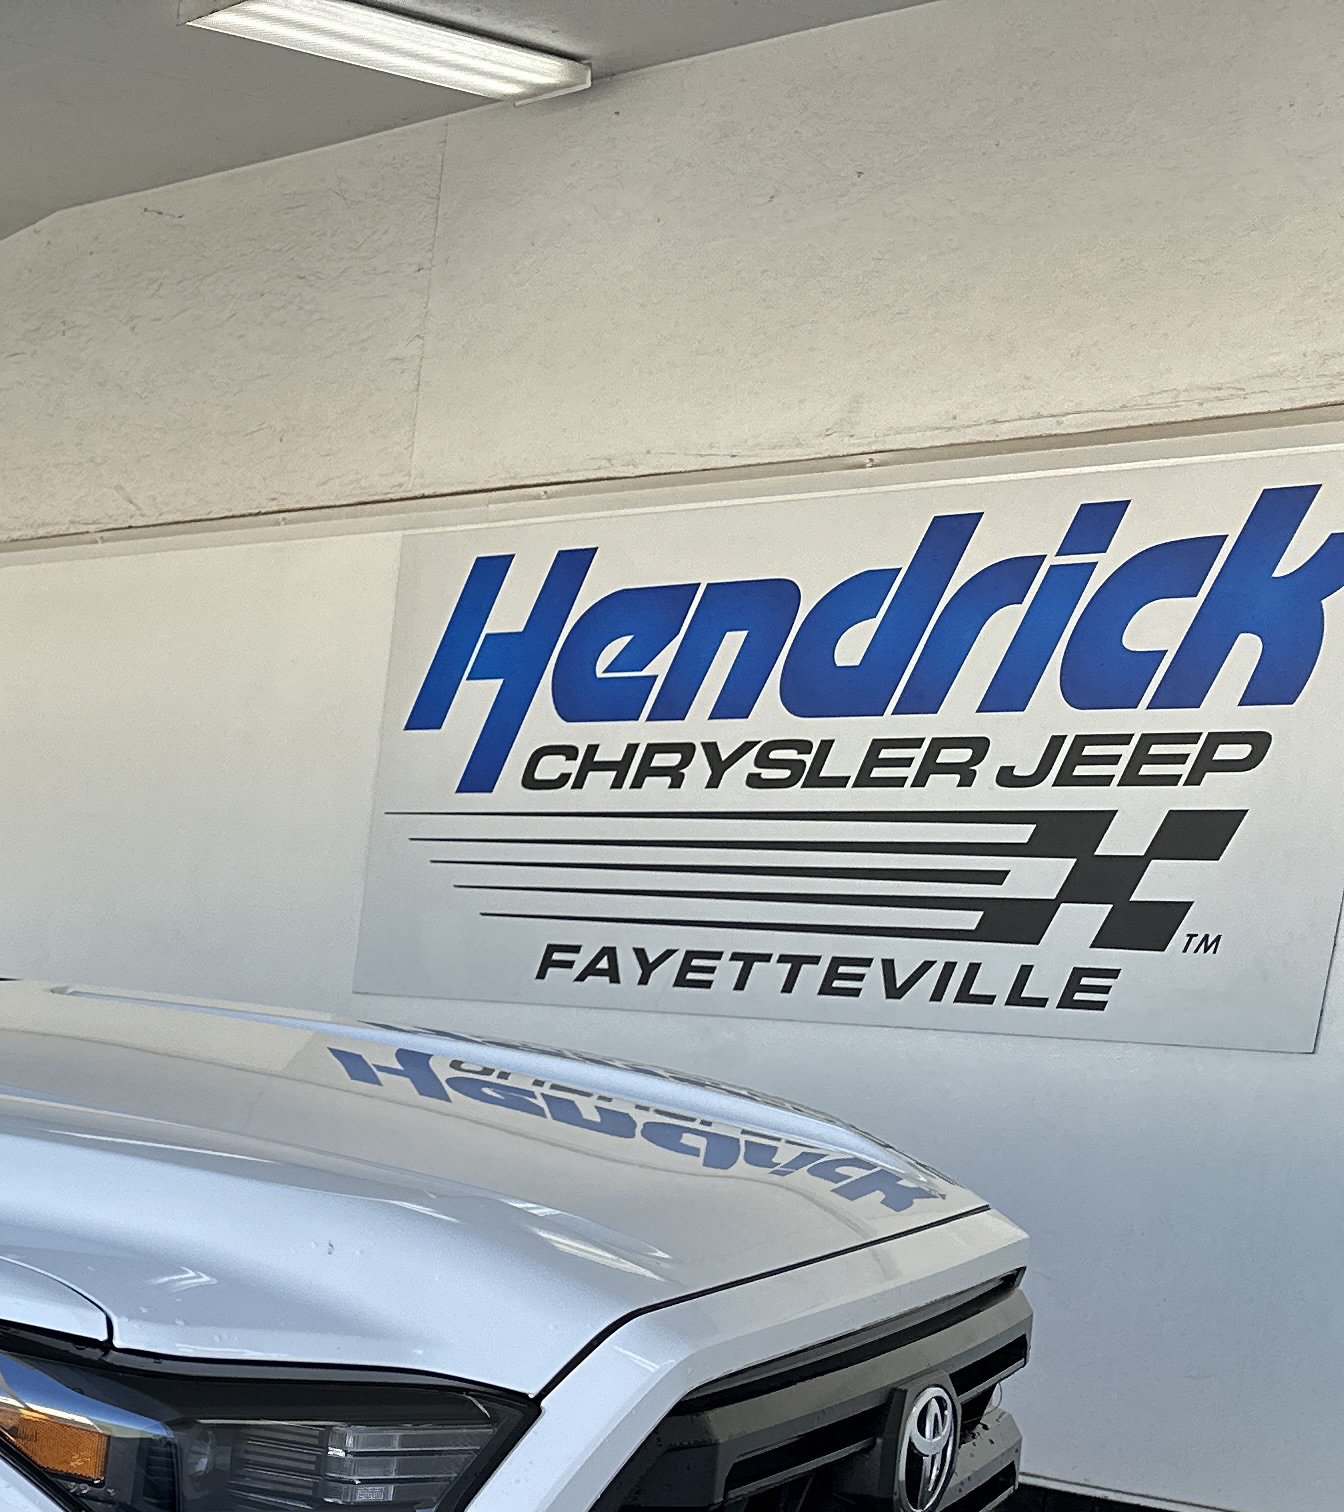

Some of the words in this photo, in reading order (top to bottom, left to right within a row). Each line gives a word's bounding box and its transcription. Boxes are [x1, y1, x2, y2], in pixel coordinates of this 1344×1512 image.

[403, 483, 1344, 793] Hendrick
[520, 735, 991, 791] CHRYSLER
[995, 730, 1273, 789] JEEP
[1180, 932, 1224, 956] TM
[534, 942, 1122, 1013] FAYETTEVILLE
